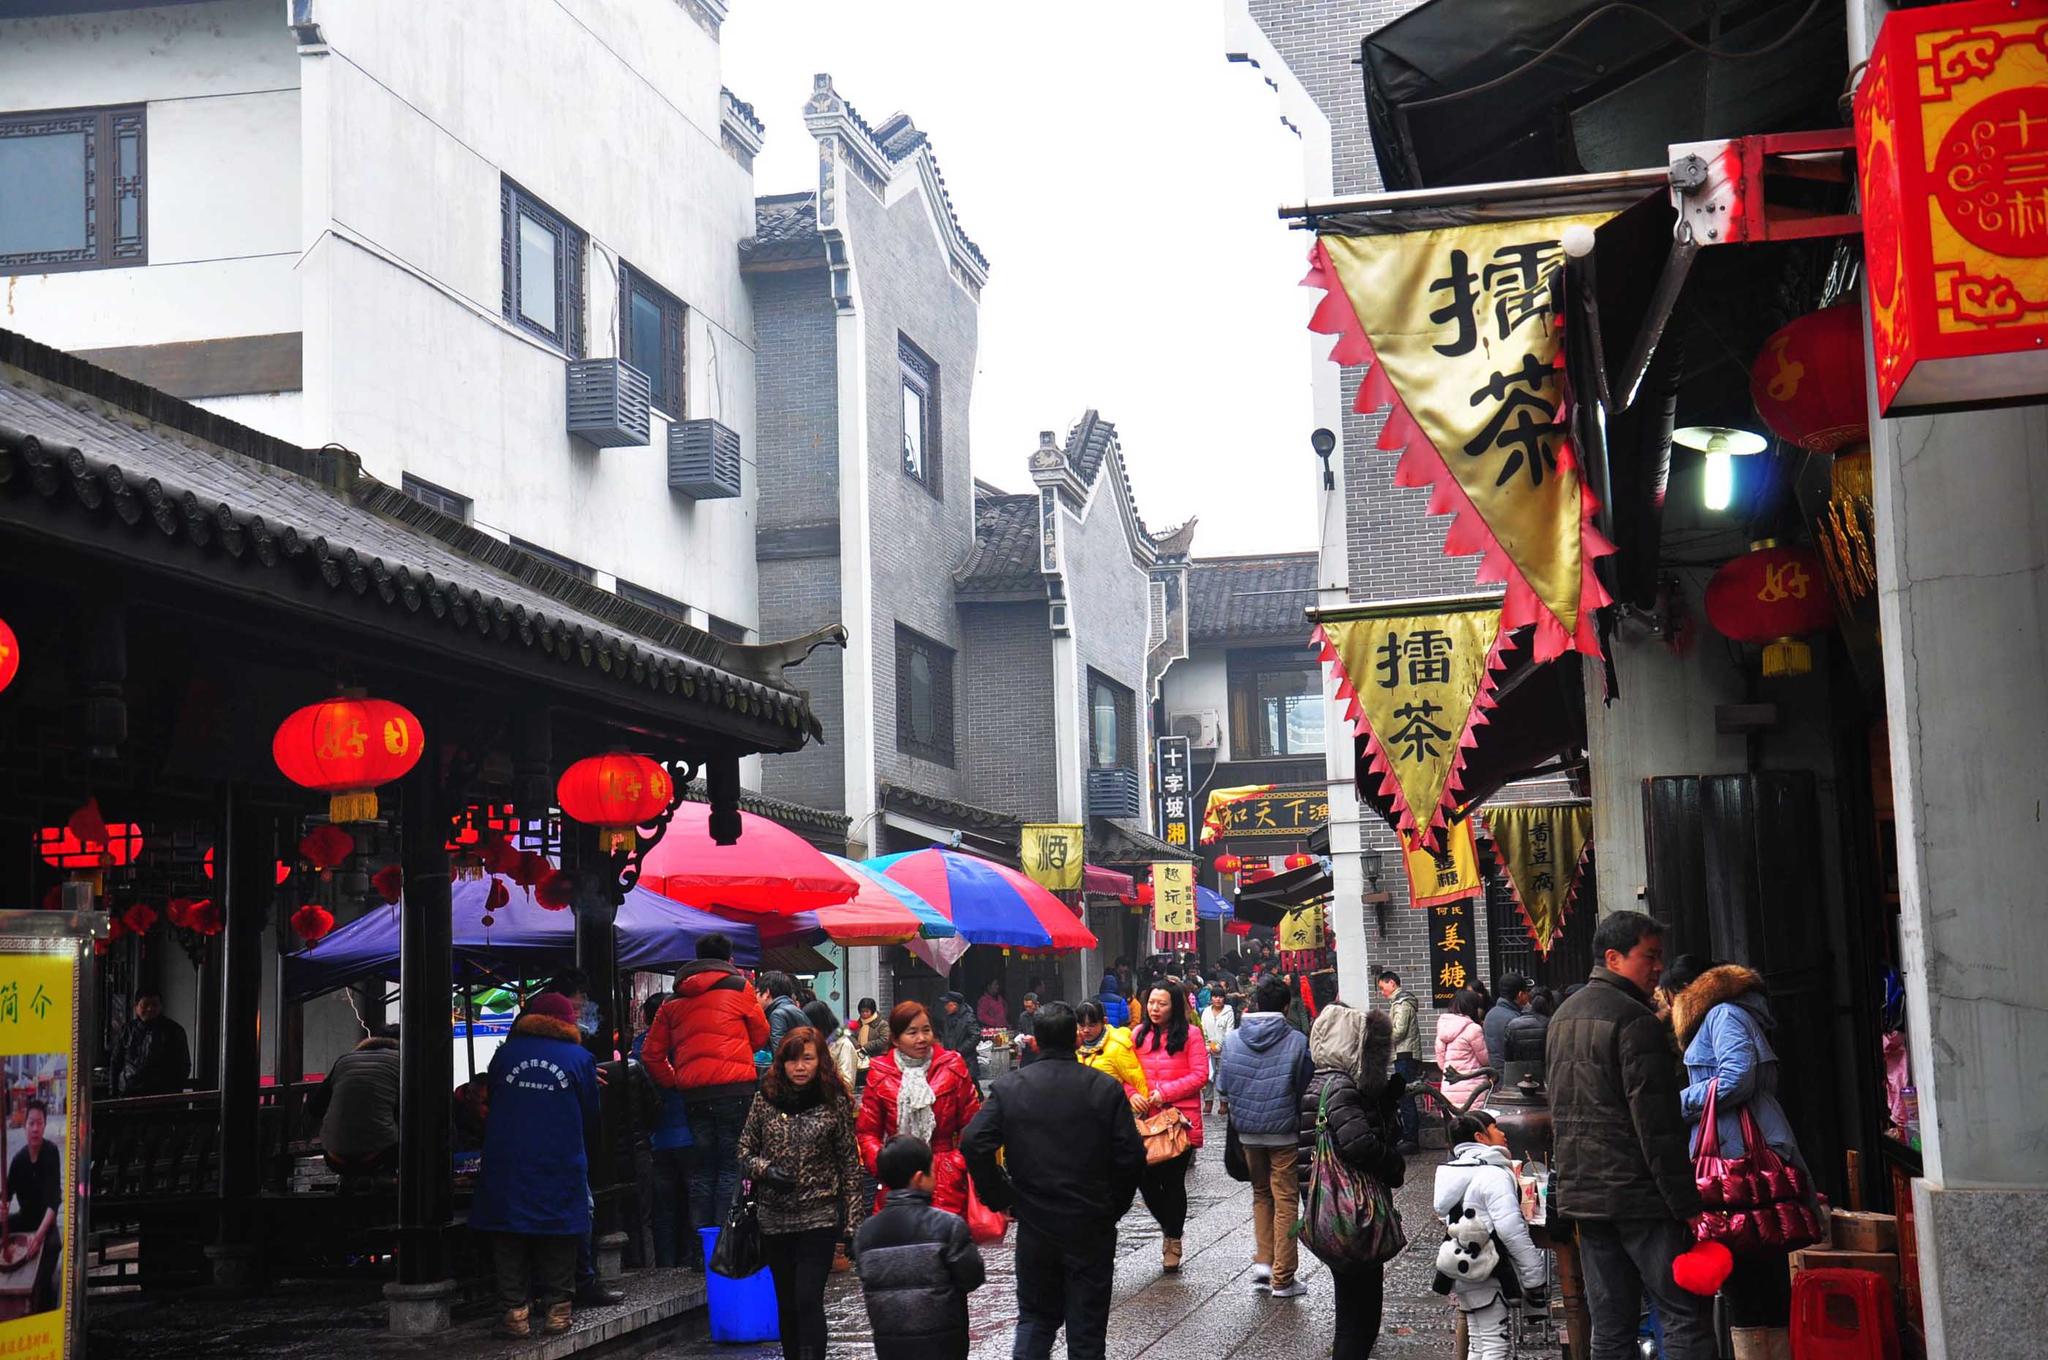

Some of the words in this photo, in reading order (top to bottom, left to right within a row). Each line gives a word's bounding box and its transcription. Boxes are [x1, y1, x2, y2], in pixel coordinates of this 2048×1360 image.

[1428, 239, 1566, 488] 擂茶
[1376, 629, 1453, 763] 擂茶
[1037, 834, 1069, 871] 酒
[1527, 822, 1554, 892] 香豆腐
[1164, 867, 1182, 925] 趣玩吧
[1435, 907, 1463, 915] 何氏
[1437, 922, 1466, 988] 姜糖
[0, 981, 53, 1024] 简介
